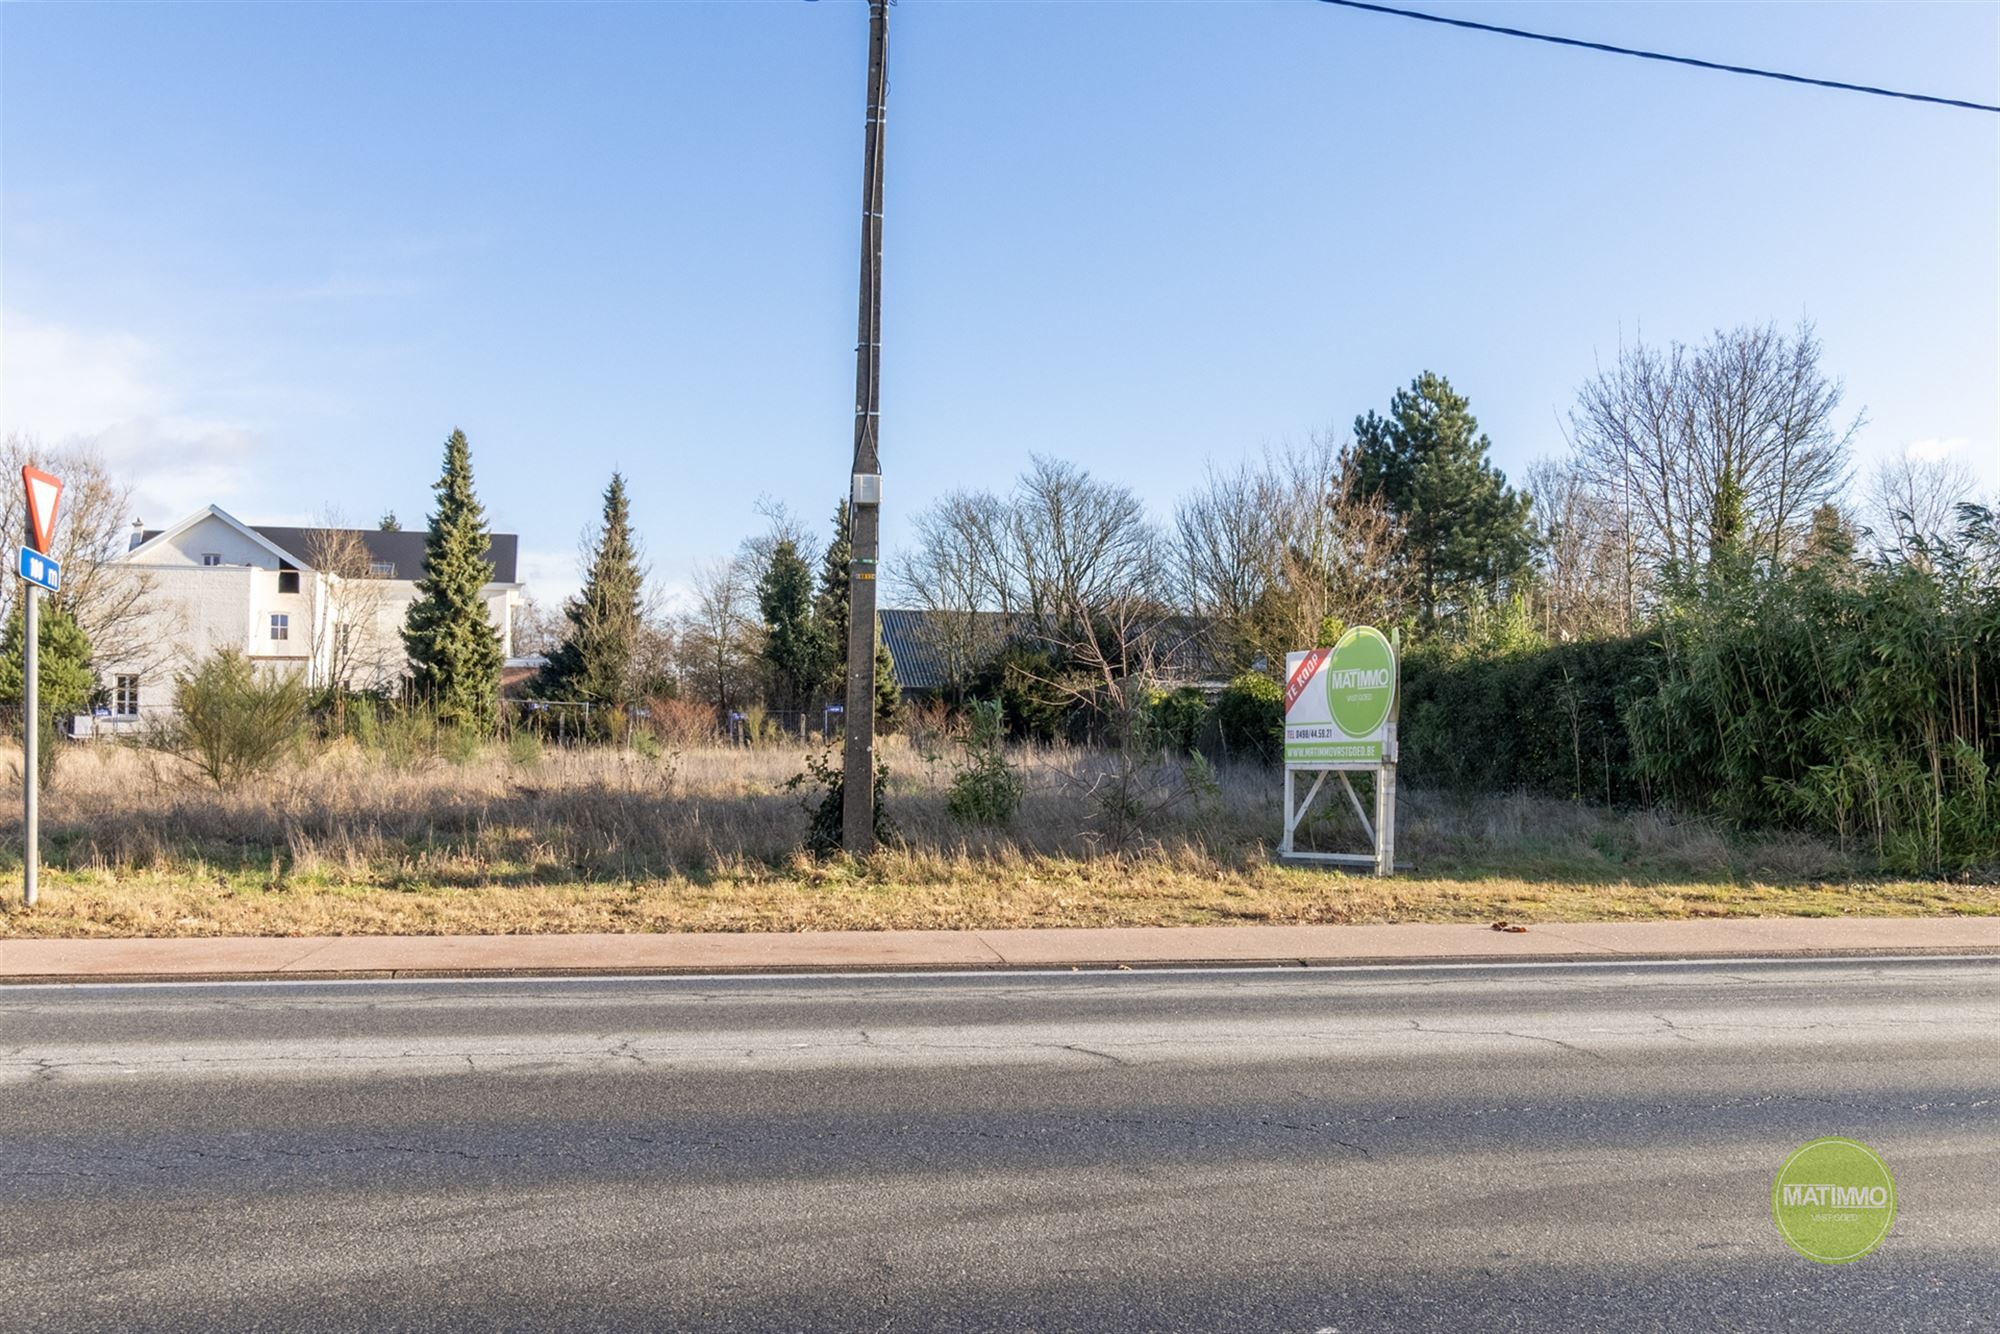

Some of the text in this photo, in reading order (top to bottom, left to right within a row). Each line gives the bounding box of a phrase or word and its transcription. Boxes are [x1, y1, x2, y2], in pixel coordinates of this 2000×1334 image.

[48, 568, 58, 588] m
[1286, 653, 1320, 701] TE KOOP
[1332, 669, 1389, 690] MATIMMO
